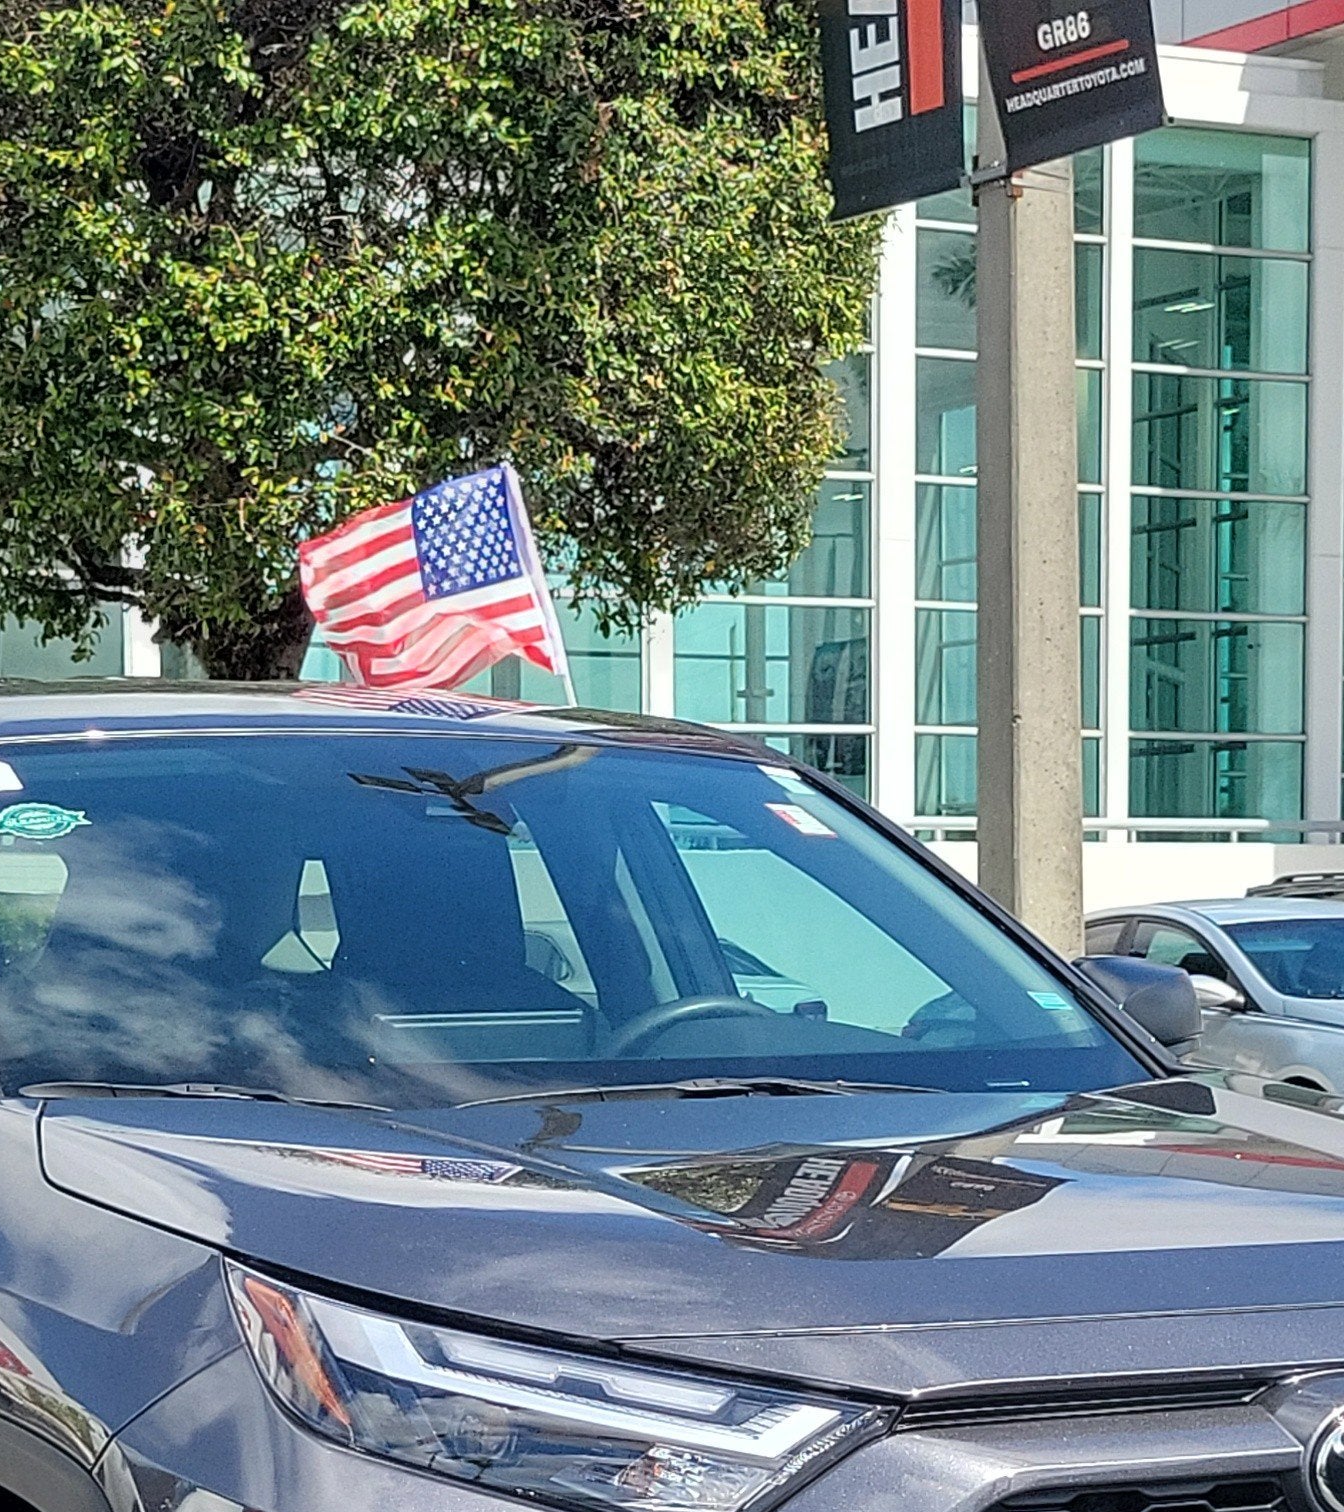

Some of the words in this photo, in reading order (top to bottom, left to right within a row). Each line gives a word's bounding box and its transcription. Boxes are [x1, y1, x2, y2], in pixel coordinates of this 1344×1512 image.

[1037, 11, 1091, 50] GR86
[848, 0, 903, 133] HE
[1005, 57, 1146, 113] HEADQUARTERTOYOTA.COM
